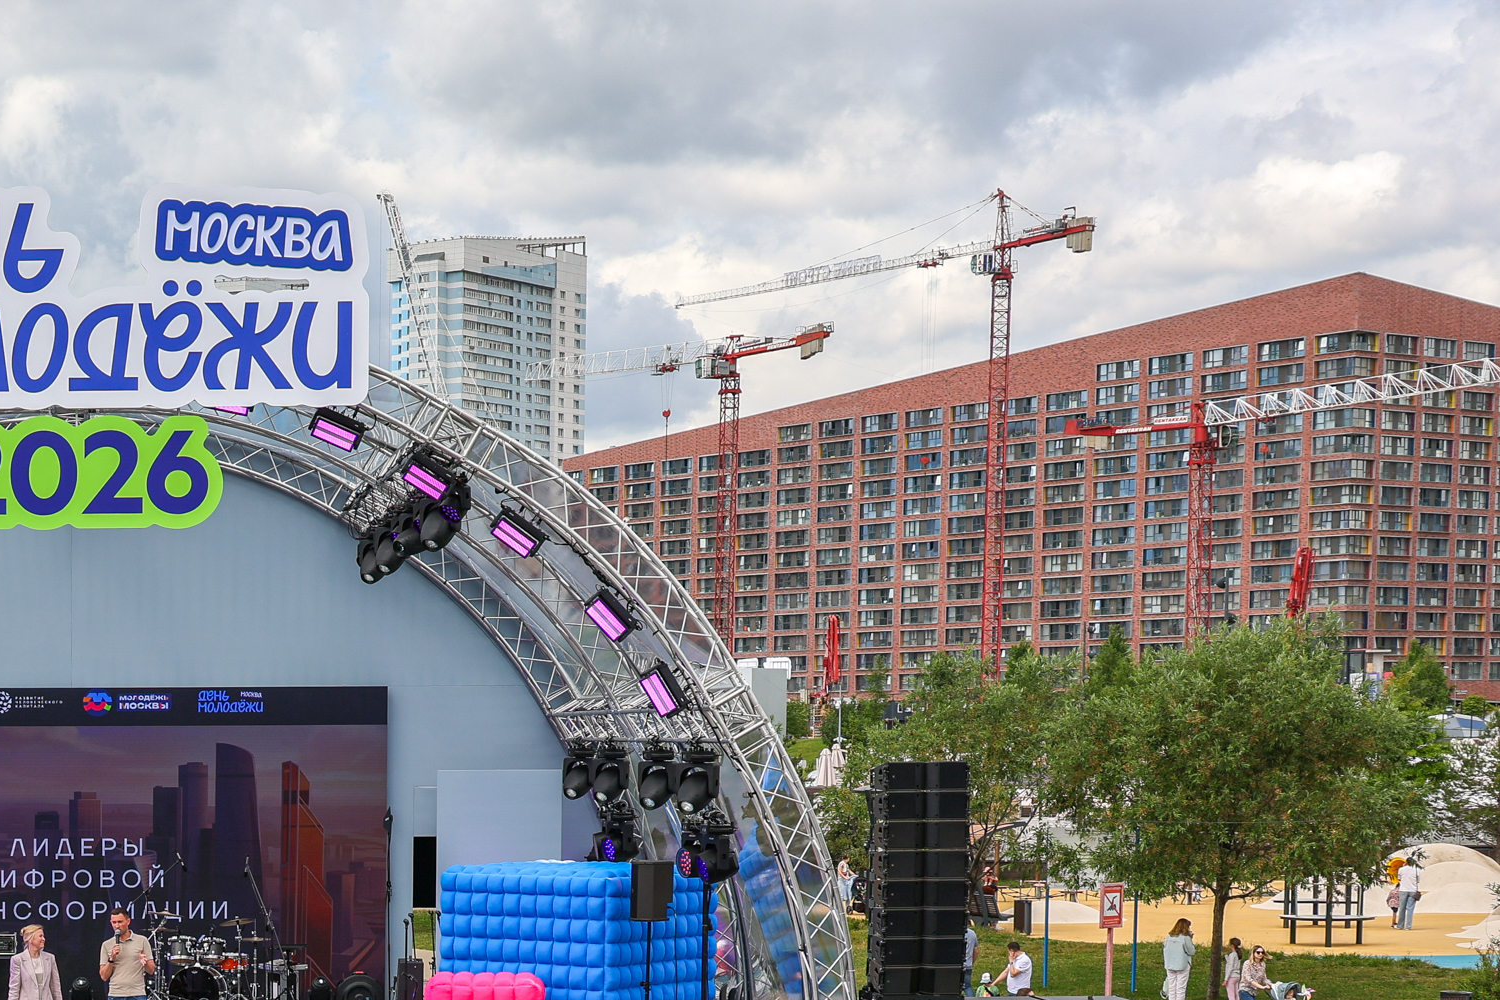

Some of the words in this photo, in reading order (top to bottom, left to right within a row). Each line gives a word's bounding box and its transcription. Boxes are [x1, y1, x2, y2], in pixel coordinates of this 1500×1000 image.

[198, 690, 230, 701] ДЕНЬ
[119, 702, 169, 710] МОСКВЫ
[10, 837, 144, 860] ЛИДЕРЫ
